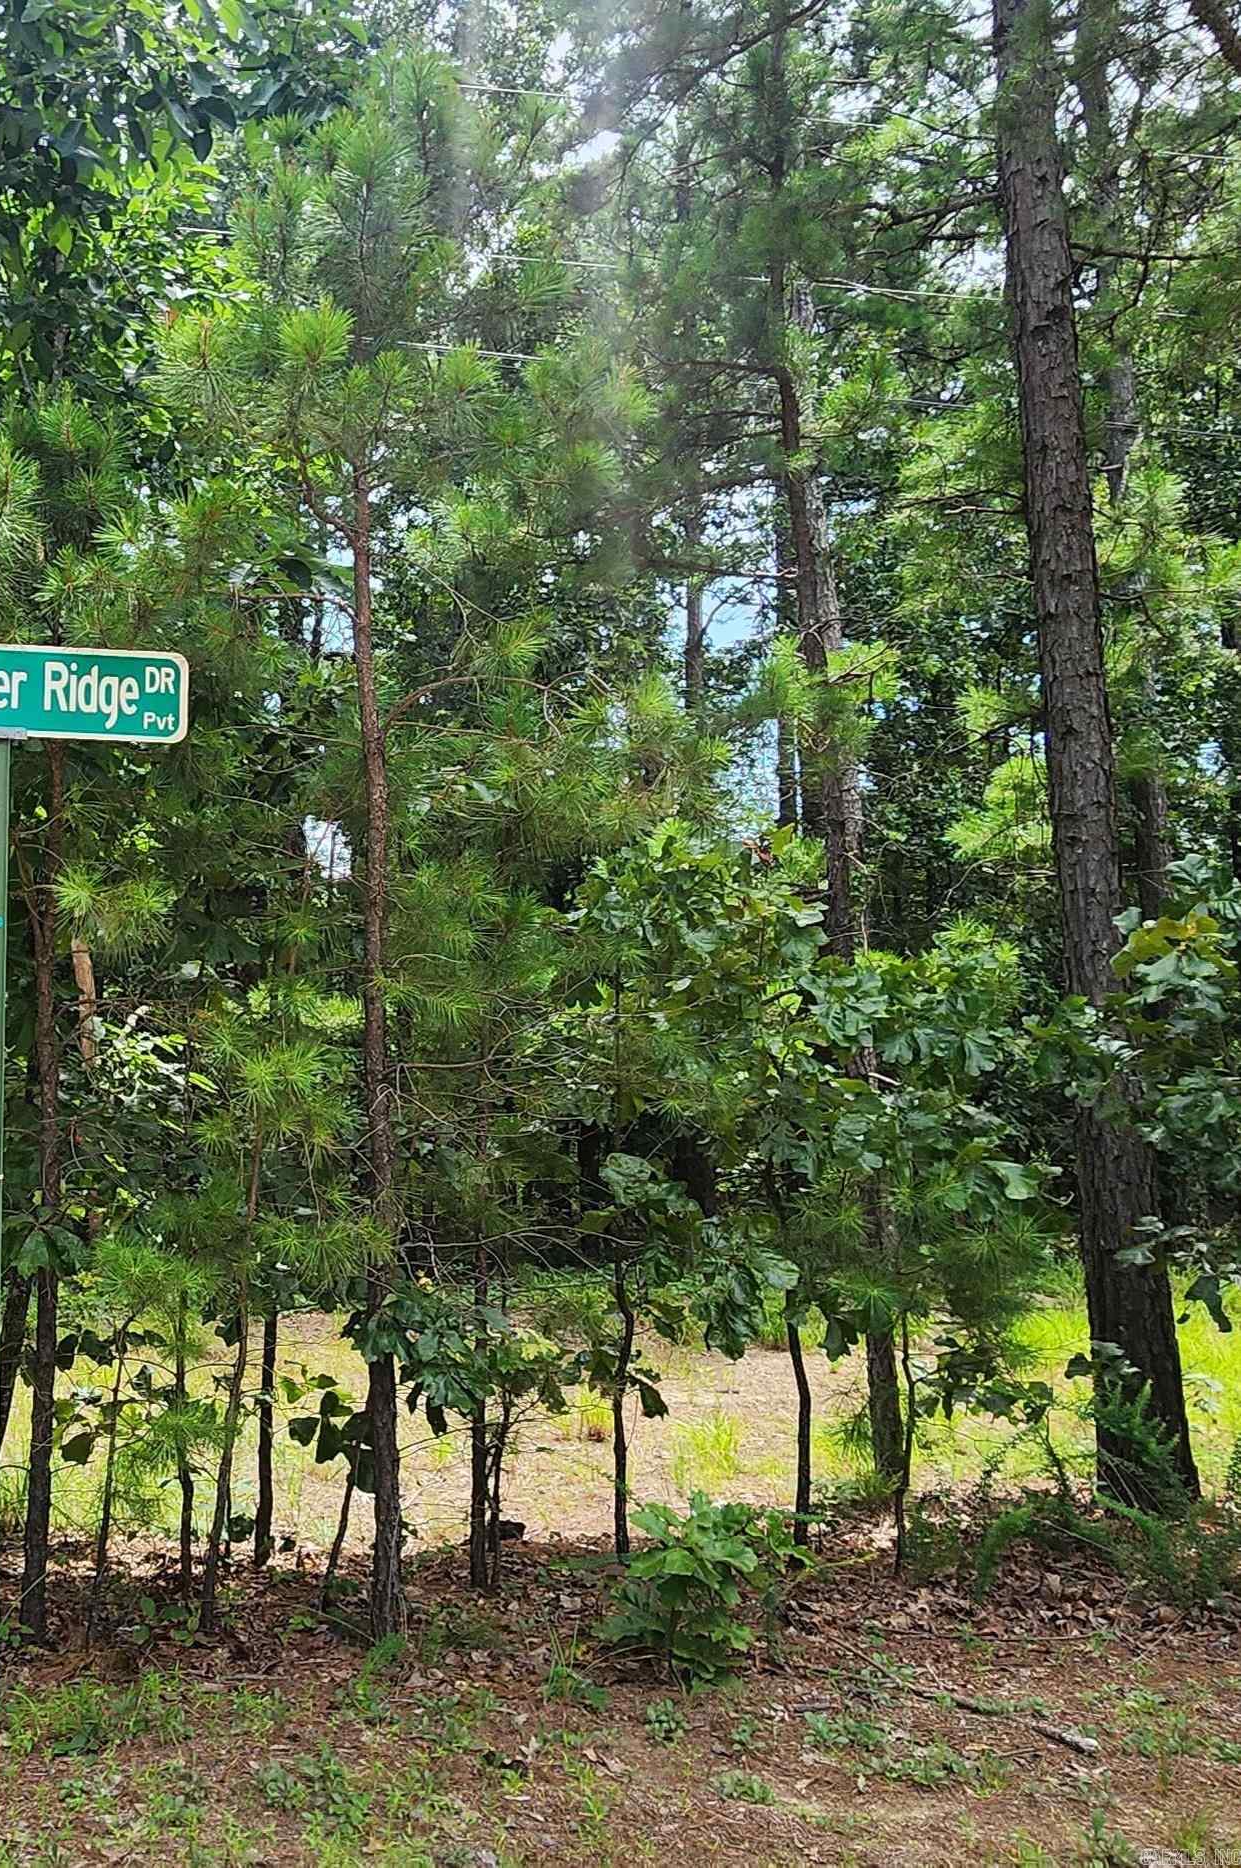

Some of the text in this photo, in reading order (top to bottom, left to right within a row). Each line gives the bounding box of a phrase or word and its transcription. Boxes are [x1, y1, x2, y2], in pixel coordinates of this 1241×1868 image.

[44, 661, 139, 729] Ridge
[145, 666, 175, 695] DR
[143, 712, 175, 731] Pvt
